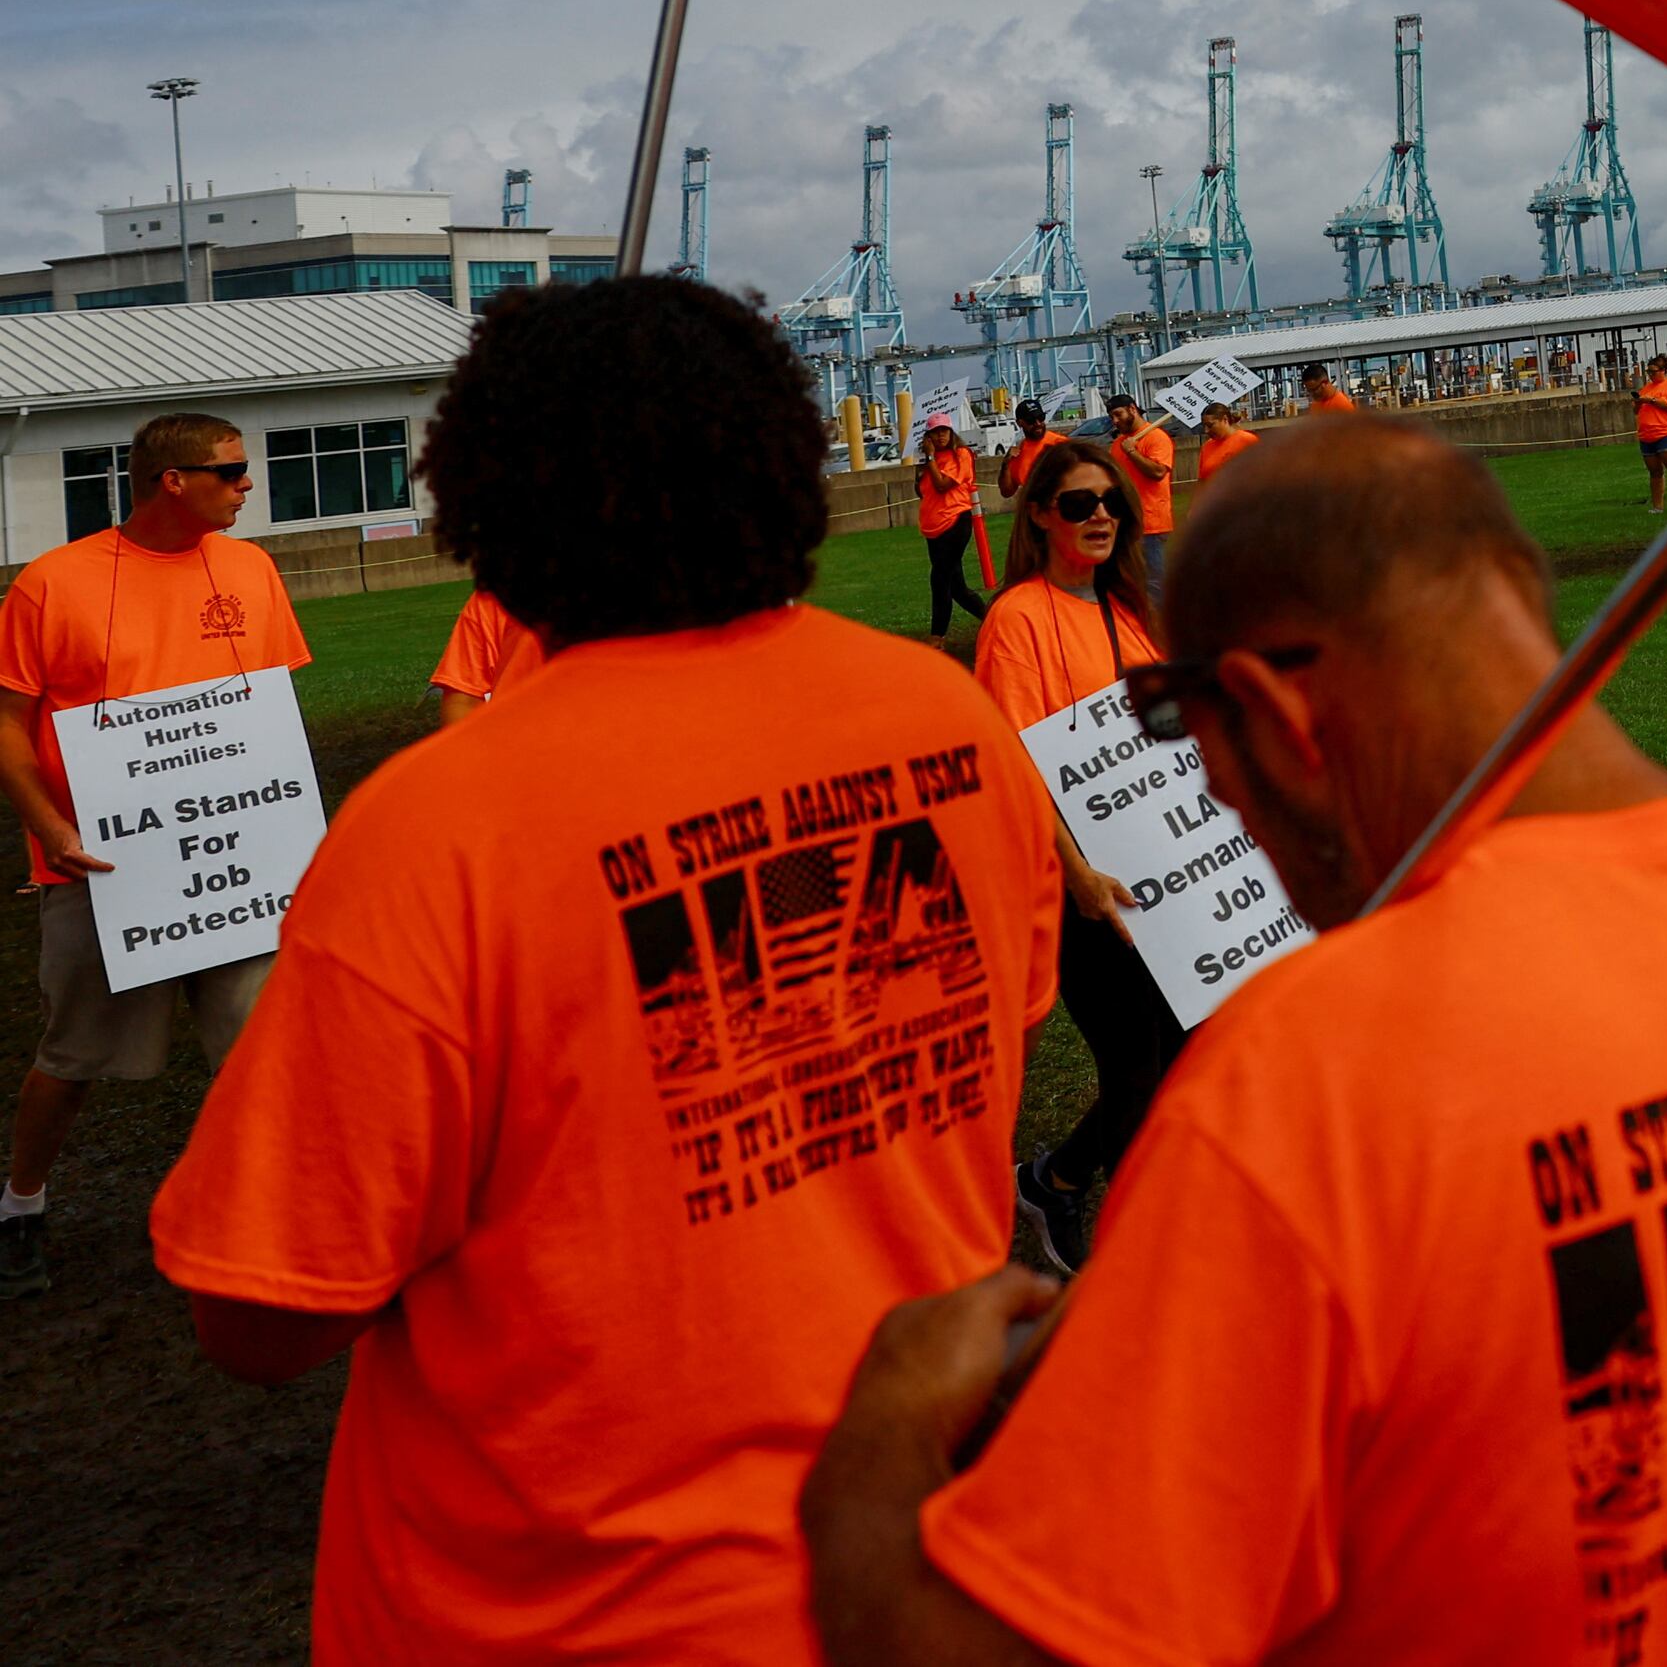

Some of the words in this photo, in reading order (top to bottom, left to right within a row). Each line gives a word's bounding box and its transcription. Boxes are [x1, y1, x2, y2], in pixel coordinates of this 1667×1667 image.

[1205, 367, 1219, 381] Save
[1212, 360, 1248, 390] Automation,
[1230, 361, 1247, 376] Fight
[921, 391, 958, 409] Workers
[934, 385, 949, 396] ILA
[1182, 394, 1198, 407] Job
[1203, 381, 1218, 394] ILA
[926, 402, 949, 414] Over
[1165, 395, 1196, 421] Security
[98, 688, 251, 731] Automation
[1087, 692, 1138, 728] Fig
[144, 720, 218, 747] Hurts
[126, 741, 247, 778] Families:
[97, 807, 163, 841] ILA
[174, 779, 303, 823] Stands
[1086, 769, 1168, 822] Save
[600, 833, 656, 900] ON
[666, 797, 772, 877] STRIKE
[782, 764, 899, 843] AGAINST
[1162, 792, 1221, 839] ILA
[178, 828, 240, 860] For
[182, 864, 251, 898] Job
[1212, 875, 1266, 922] Job
[121, 892, 293, 953] Protectio
[1193, 904, 1311, 985] Securit
[1529, 1124, 1601, 1228] ON
